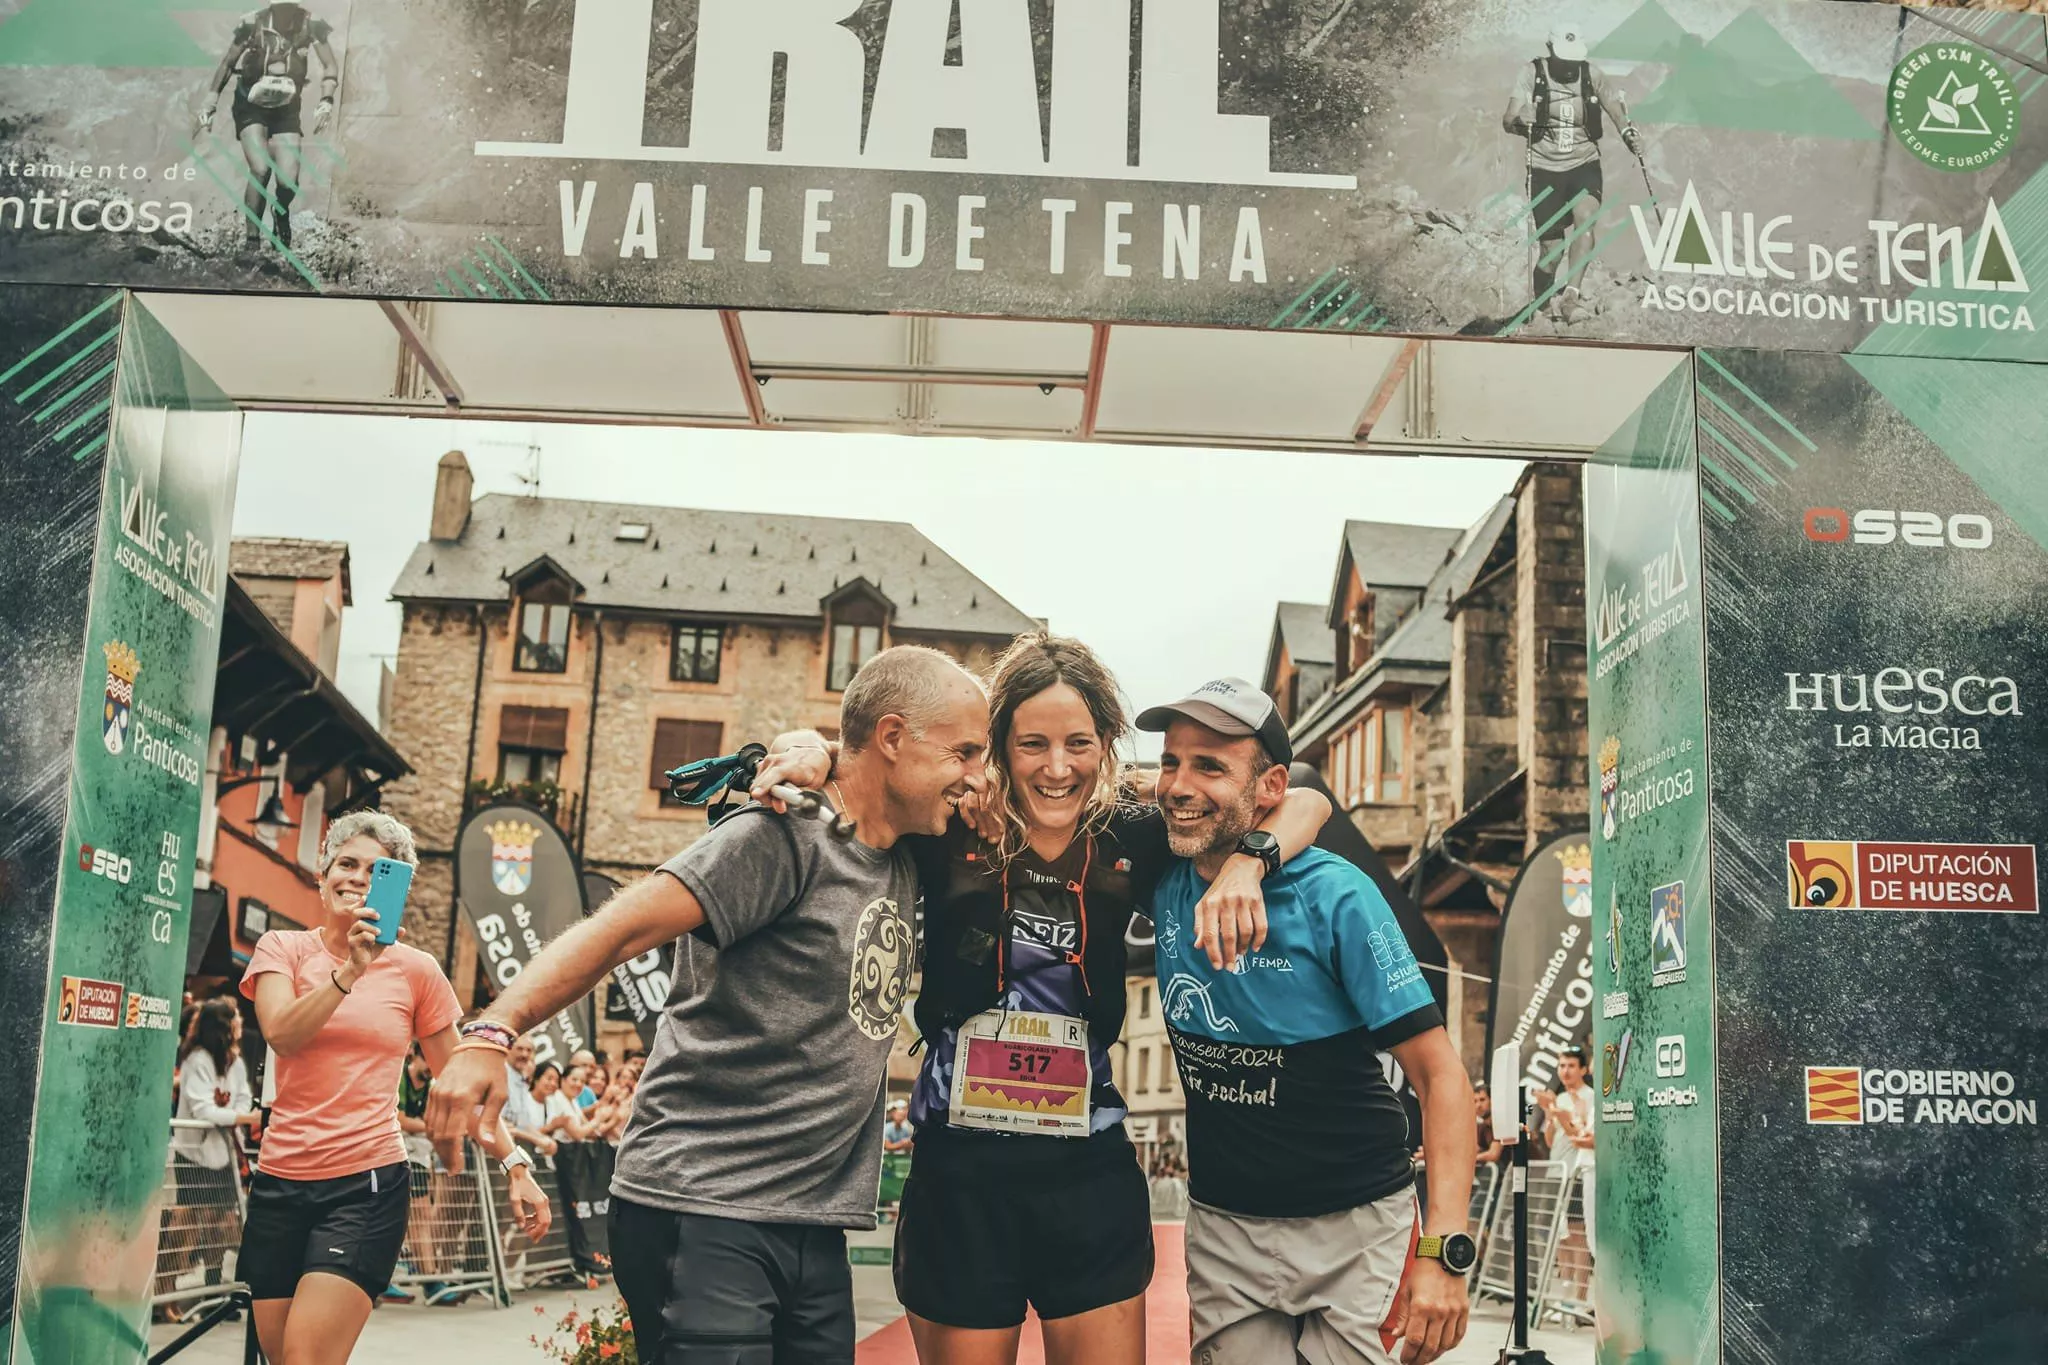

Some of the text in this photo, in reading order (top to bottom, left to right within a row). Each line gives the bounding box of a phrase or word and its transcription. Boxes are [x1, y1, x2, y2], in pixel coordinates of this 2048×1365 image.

[1893, 48, 2013, 106] GREEN CXM TRAIL
[0, 160, 197, 181] tamiento de
[558, 180, 1268, 285] VALLE DE TENA
[1641, 284, 2035, 331] ASOCIACION TURISTICA
[114, 542, 215, 629] ASOCIACION TURISTICA
[1596, 600, 1690, 681] ASOCIACION TURISTICA
[133, 721, 199, 786] Panticosa
[1621, 768, 1694, 823] Panticosa
[1868, 851, 2012, 877] DIPUTACIÓN
[1870, 881, 2014, 903] DE HUESCA
[1560, 924, 1581, 948] de
[88, 1005, 114, 1022] HUESCA
[1008, 1016, 1051, 1038] TRAIL
[1069, 1025, 1078, 1041] R
[1008, 1053, 1052, 1074] 517
[1228, 1048, 1285, 1069] 2024
[1864, 1069, 2015, 1096] GOBIERNO
[1866, 1098, 2037, 1125] DE ARAGON
